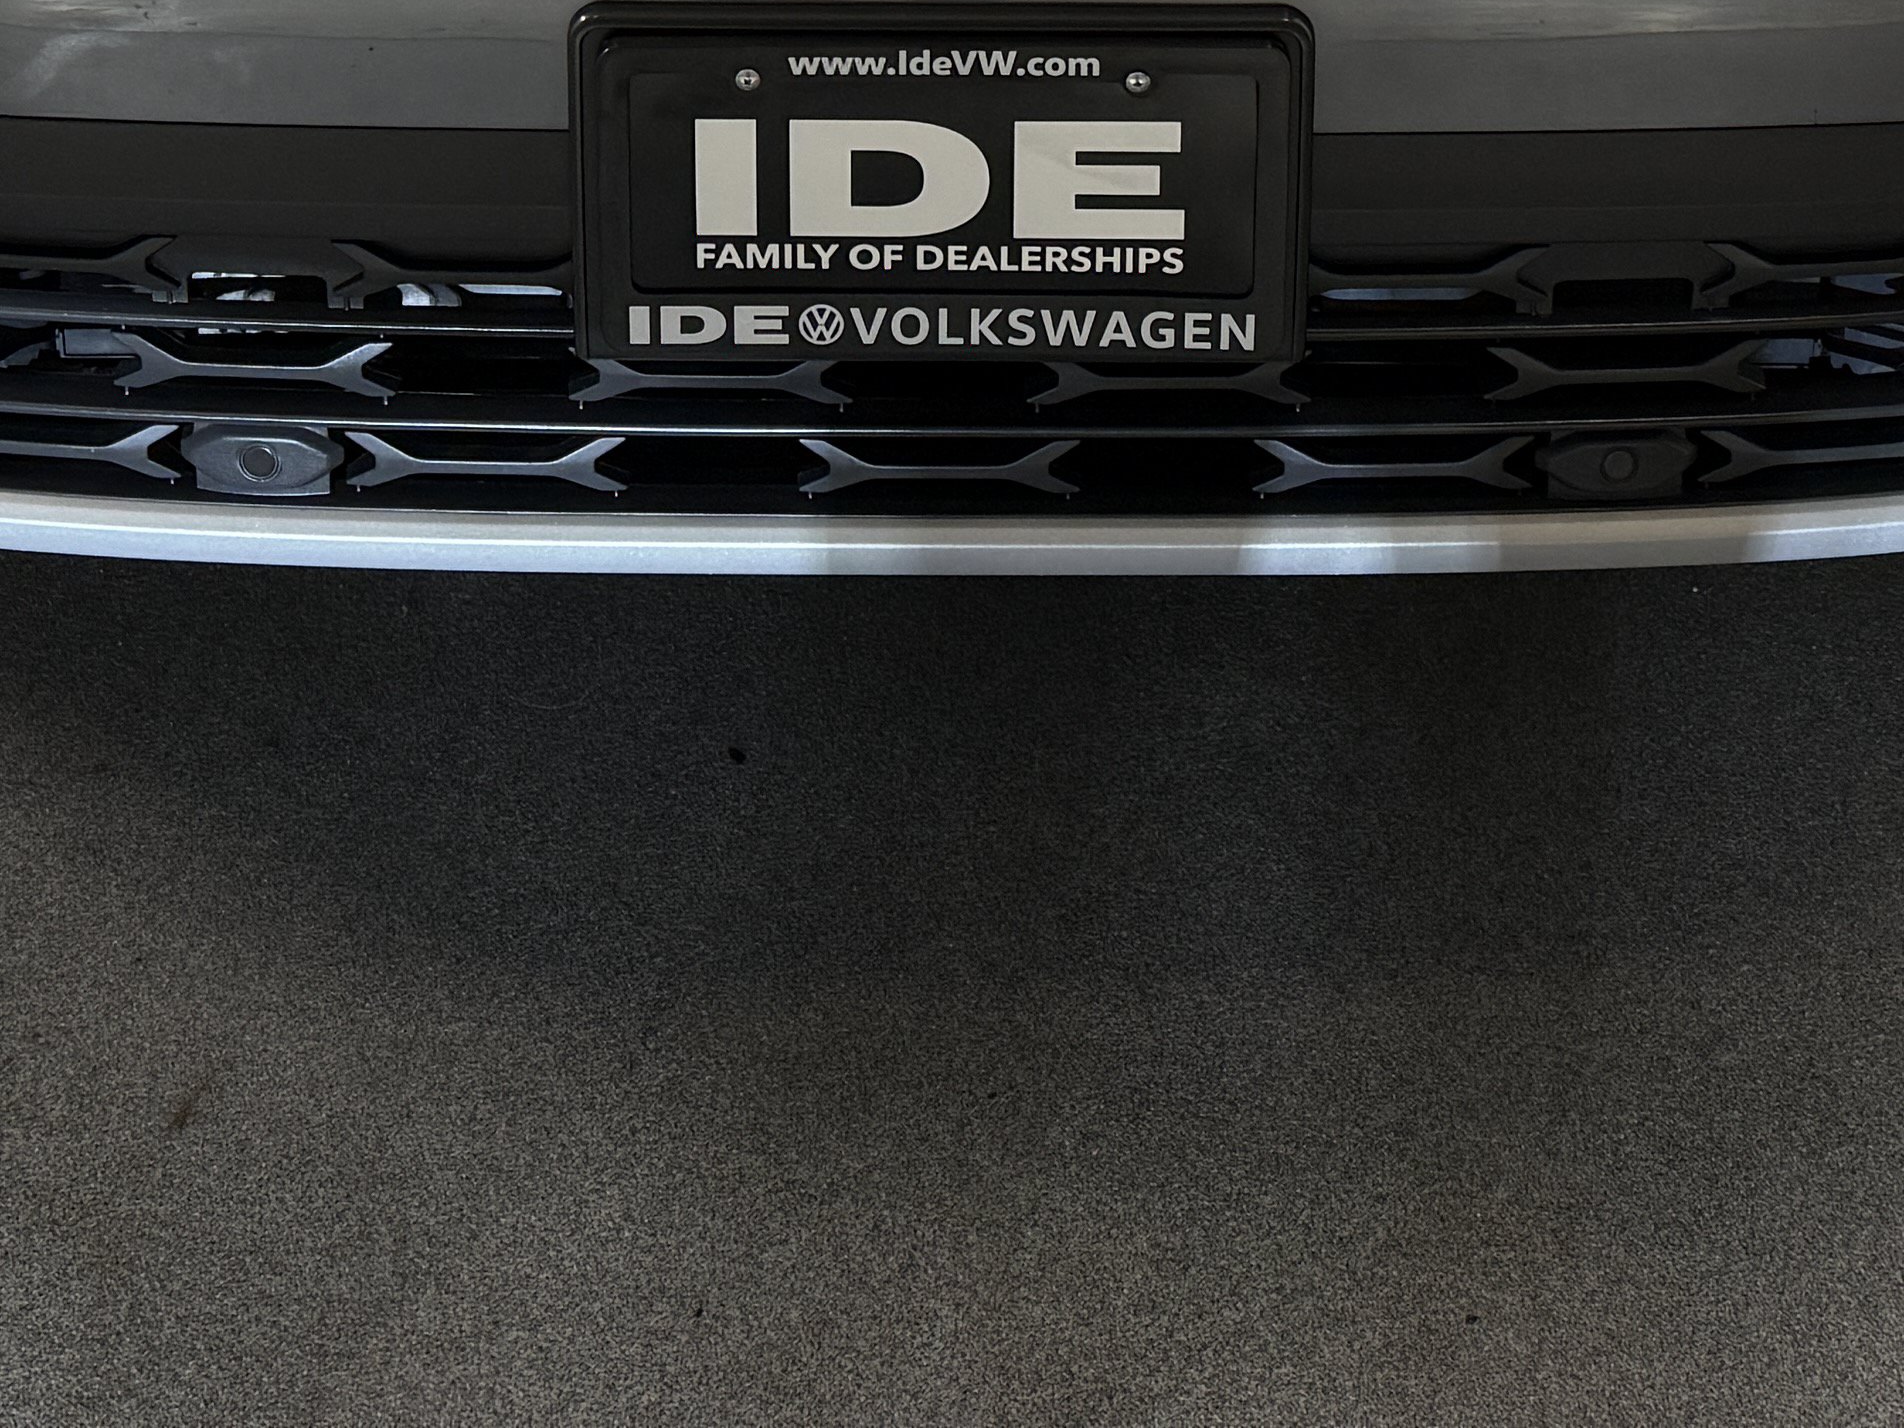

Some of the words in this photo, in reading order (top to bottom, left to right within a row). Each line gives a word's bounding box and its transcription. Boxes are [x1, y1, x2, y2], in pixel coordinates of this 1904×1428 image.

[787, 49, 1100, 77] www.IdeVW.com
[694, 118, 1186, 241] IDE
[696, 242, 840, 270] FAMILY
[848, 243, 904, 271] OF
[916, 244, 1184, 275] DEALERSHIPS
[628, 305, 790, 345] IDE
[849, 306, 1256, 351] VOLKSWAGEN
